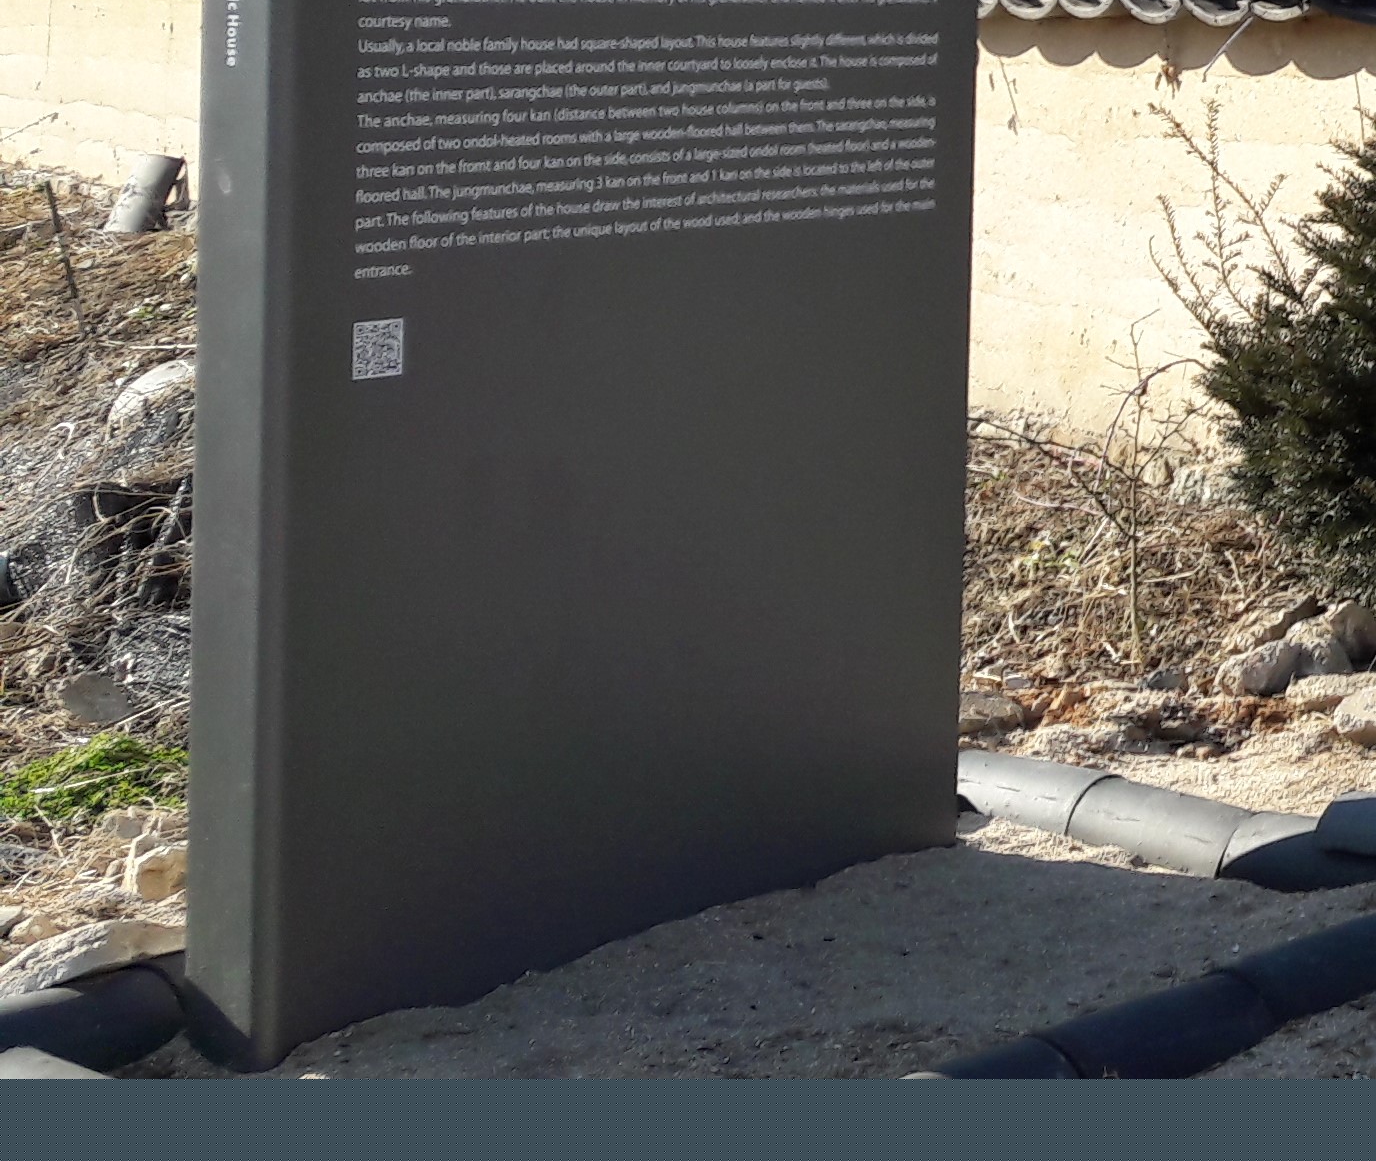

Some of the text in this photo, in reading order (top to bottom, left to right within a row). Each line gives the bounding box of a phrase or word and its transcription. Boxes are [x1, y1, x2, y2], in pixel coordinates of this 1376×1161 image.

[358, 17, 451, 31] courtesy name.
[226, 14, 240, 66] House
[359, 40, 405, 55] Usually,
[406, 43, 414, 52] a
[416, 39, 445, 52] local
[447, 39, 481, 52] noble
[483, 38, 518, 54] family
[521, 38, 555, 51] house
[358, 68, 371, 78] as
[374, 67, 399, 78] two
[452, 62, 476, 77] and
[479, 62, 511, 76] those
[514, 65, 533, 74] are
[534, 61, 573, 76] placed
[357, 90, 403, 103] anchae
[405, 88, 430, 103] (the
[432, 89, 463, 101] inner
[498, 86, 563, 101] sarangchae
[357, 115, 381, 128] The
[384, 113, 432, 128] anchae,
[435, 112, 500, 126] measuring
[503, 110, 527, 123] four
[356, 138, 421, 155] composed
[423, 136, 436, 151] of
[438, 139, 461, 150] two
[542, 134, 577, 145] rooms
[356, 166, 389, 179] three
[417, 165, 434, 176] on
[436, 162, 456, 175] the
[493, 158, 516, 172] and
[518, 156, 542, 170] four
[356, 189, 400, 203] floored
[428, 186, 450, 199] The
[536, 179, 594, 193] measuring
[356, 217, 384, 231] part.
[386, 213, 409, 226] The
[411, 211, 469, 225] following
[471, 208, 518, 221] features
[521, 204, 533, 218] of
[535, 204, 555, 216] the
[355, 239, 406, 253] wooden
[409, 236, 438, 249] floor
[441, 233, 454, 247] of
[456, 233, 477, 246] the
[479, 231, 521, 244] interior
[355, 265, 412, 279] entrance.
